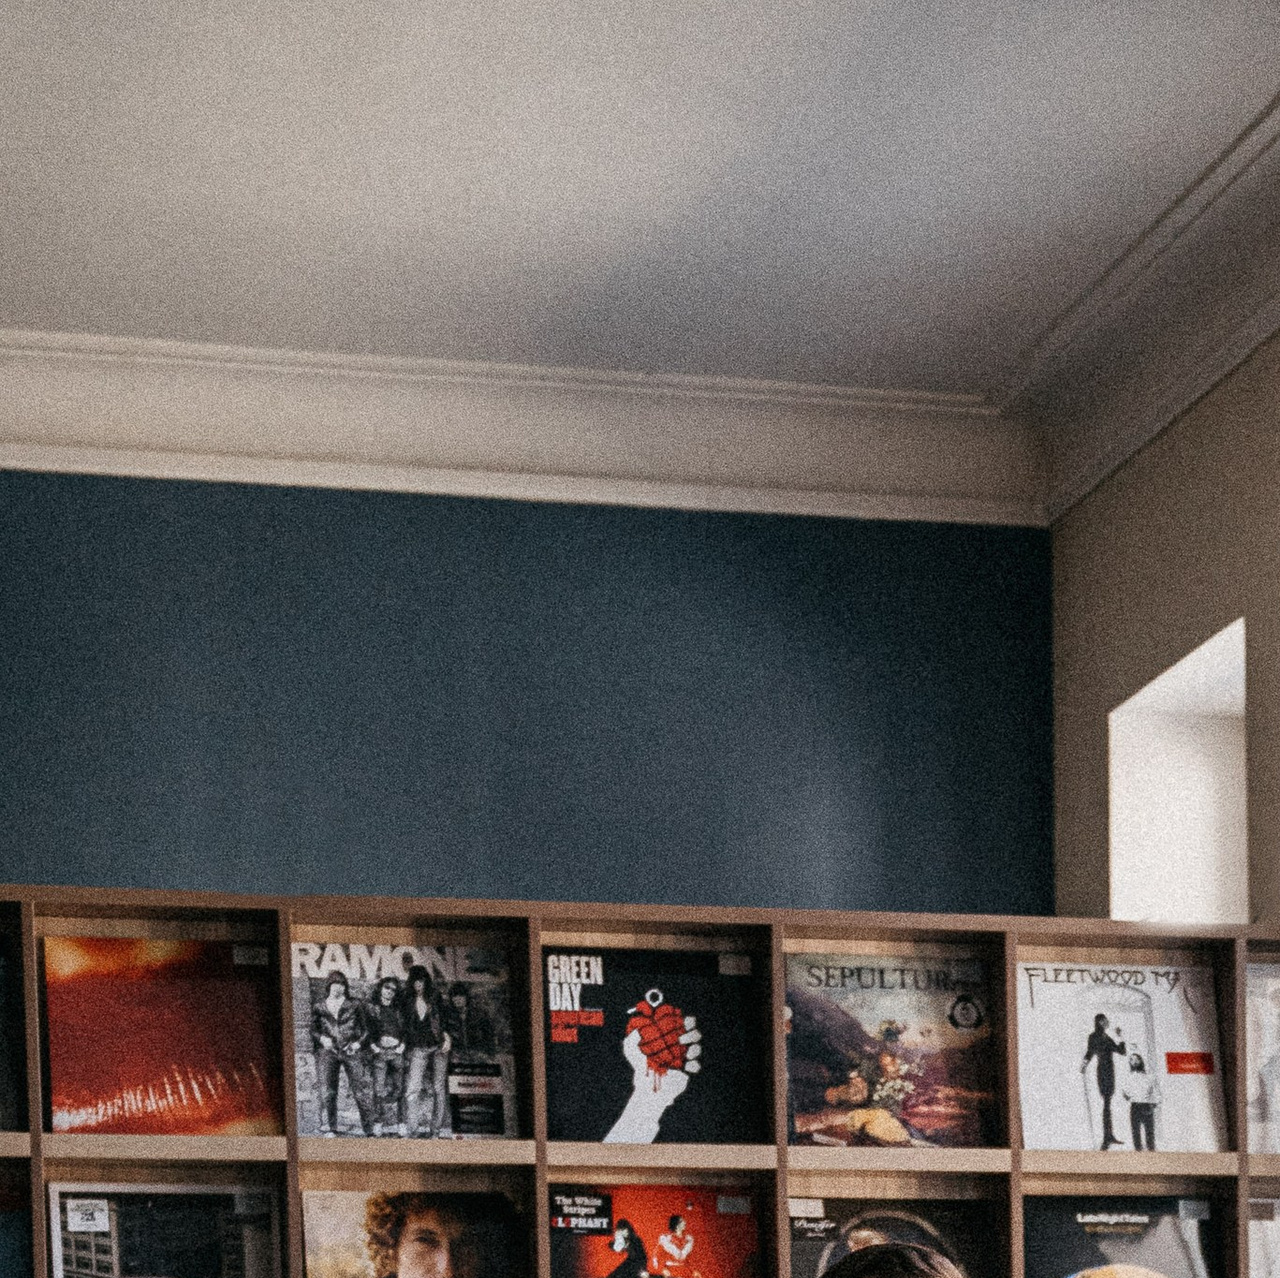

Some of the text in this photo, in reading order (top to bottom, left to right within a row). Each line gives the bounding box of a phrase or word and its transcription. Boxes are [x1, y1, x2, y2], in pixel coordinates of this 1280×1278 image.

[291, 943, 509, 982] RAMONE
[547, 954, 604, 985] GREEN
[807, 965, 966, 992] SEPULTUR
[1023, 967, 1146, 1008] FLEETWOOD
[549, 983, 582, 1011] DAY
